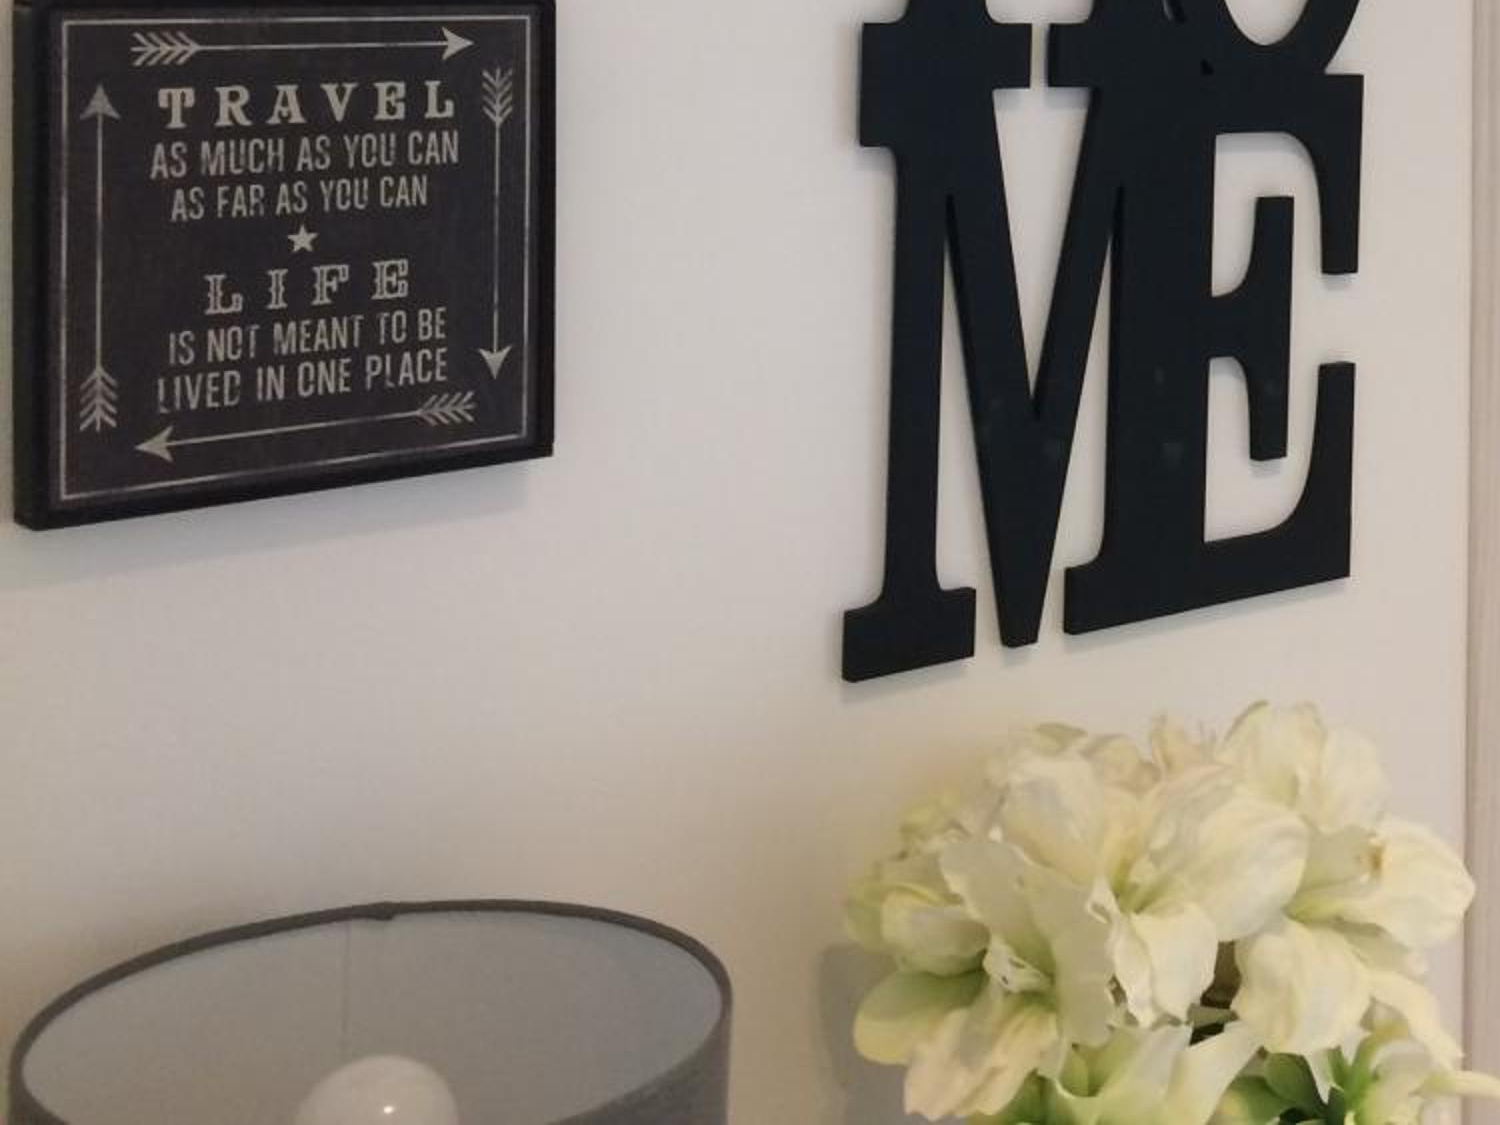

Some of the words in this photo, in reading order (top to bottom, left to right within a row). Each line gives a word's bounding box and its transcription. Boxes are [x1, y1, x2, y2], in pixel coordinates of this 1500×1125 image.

[158, 80, 454, 129] TRAVEL
[150, 141, 187, 179] AS
[201, 138, 285, 176] MUCH
[296, 136, 331, 172] AS
[344, 133, 397, 169] YOU
[408, 130, 459, 165] CAN
[171, 186, 205, 222] AS
[217, 183, 266, 218] FAR
[276, 180, 309, 215] AS
[320, 178, 369, 212] YOU
[380, 175, 428, 208] CAN
[205, 258, 409, 315] LIFE
[169, 330, 195, 366] IS
[207, 324, 260, 362] NOT
[273, 315, 364, 356] MEANT
[379, 310, 407, 345] TO
[418, 306, 447, 341] BE
[158, 371, 241, 414] LIVED
[257, 365, 285, 402] IN
[297, 357, 352, 398] ONE
[365, 347, 447, 390] PLACE
